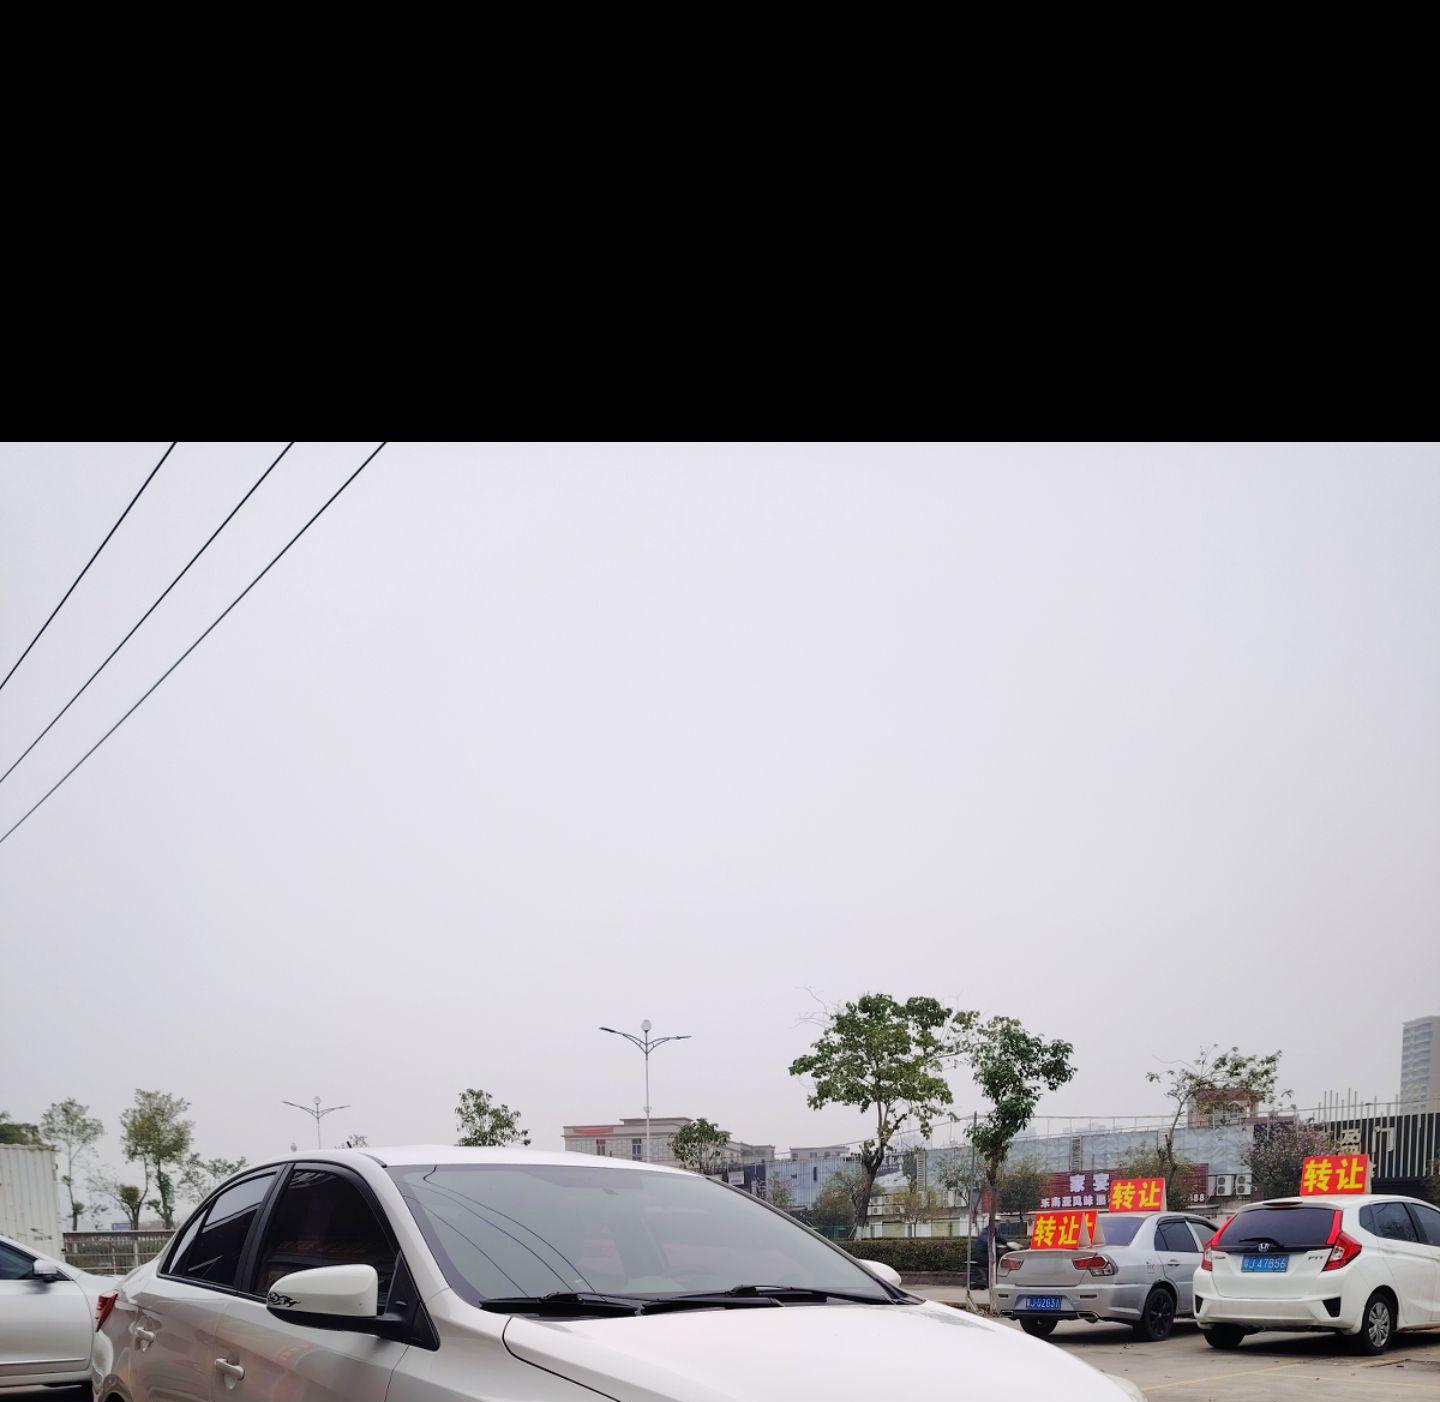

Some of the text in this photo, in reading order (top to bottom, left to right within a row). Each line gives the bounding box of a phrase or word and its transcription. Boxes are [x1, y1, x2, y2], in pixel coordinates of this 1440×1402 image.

[1303, 1158, 1364, 1192] 转让
[1112, 1180, 1161, 1210] 转让
[1034, 1215, 1080, 1247] 转让
